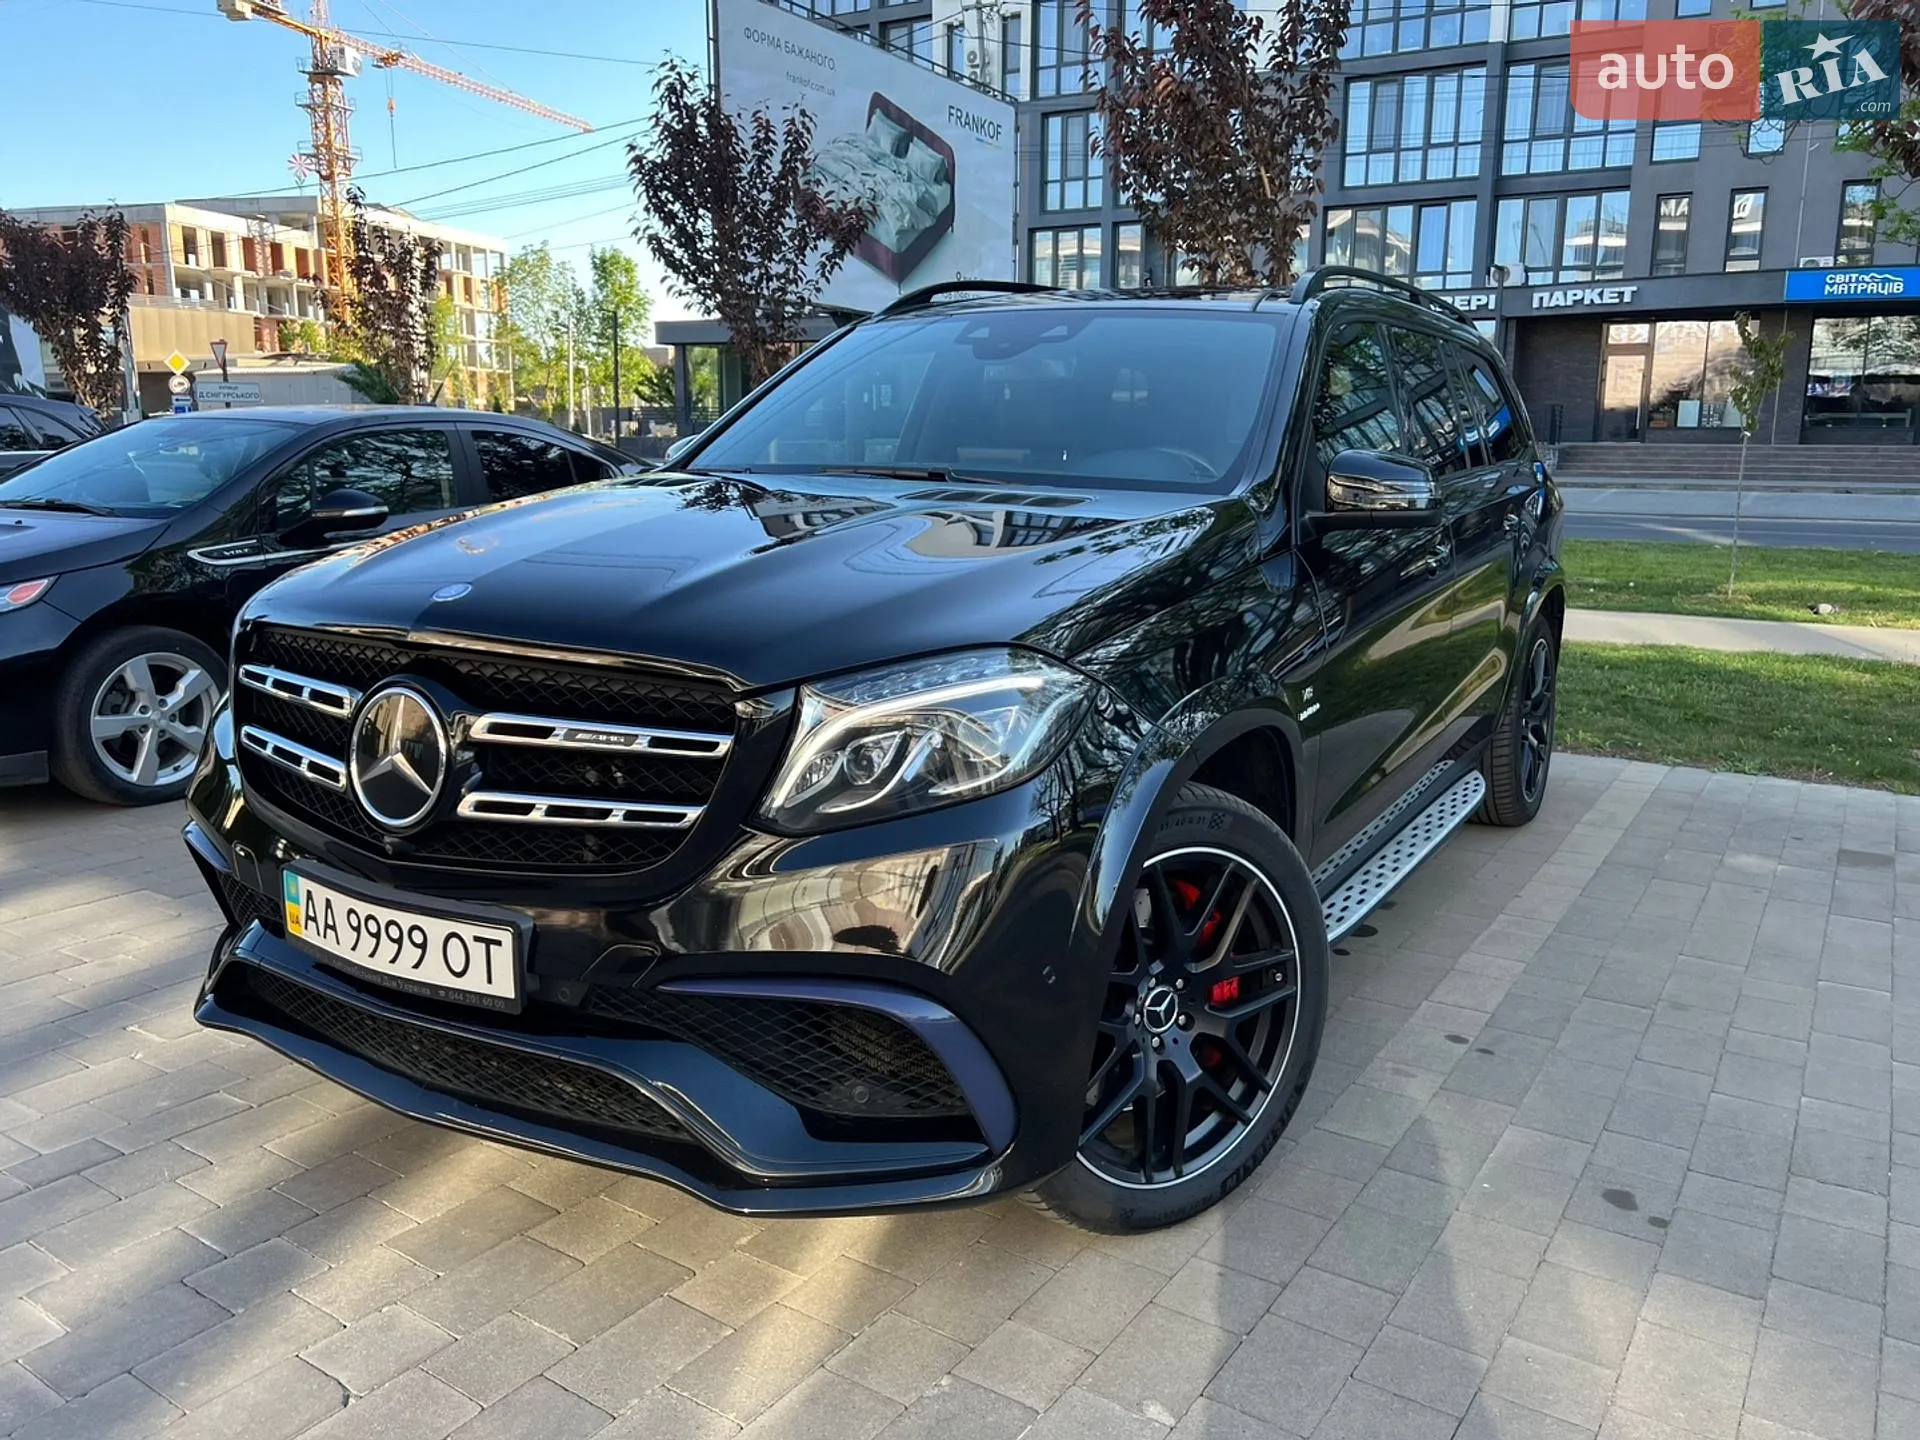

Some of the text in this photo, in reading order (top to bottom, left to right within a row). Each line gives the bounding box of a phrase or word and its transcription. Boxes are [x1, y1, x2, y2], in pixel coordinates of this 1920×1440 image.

[743, 26, 782, 52] ФОРМА
[948, 104, 1002, 141] FRANKOF
[1438, 286, 1638, 311] ЕРІ ПАРКЕТ
[1824, 281, 1904, 296] МАТРАЦІВ
[304, 889, 340, 946] AA
[346, 907, 428, 970] 9999
[442, 931, 503, 985] OT
